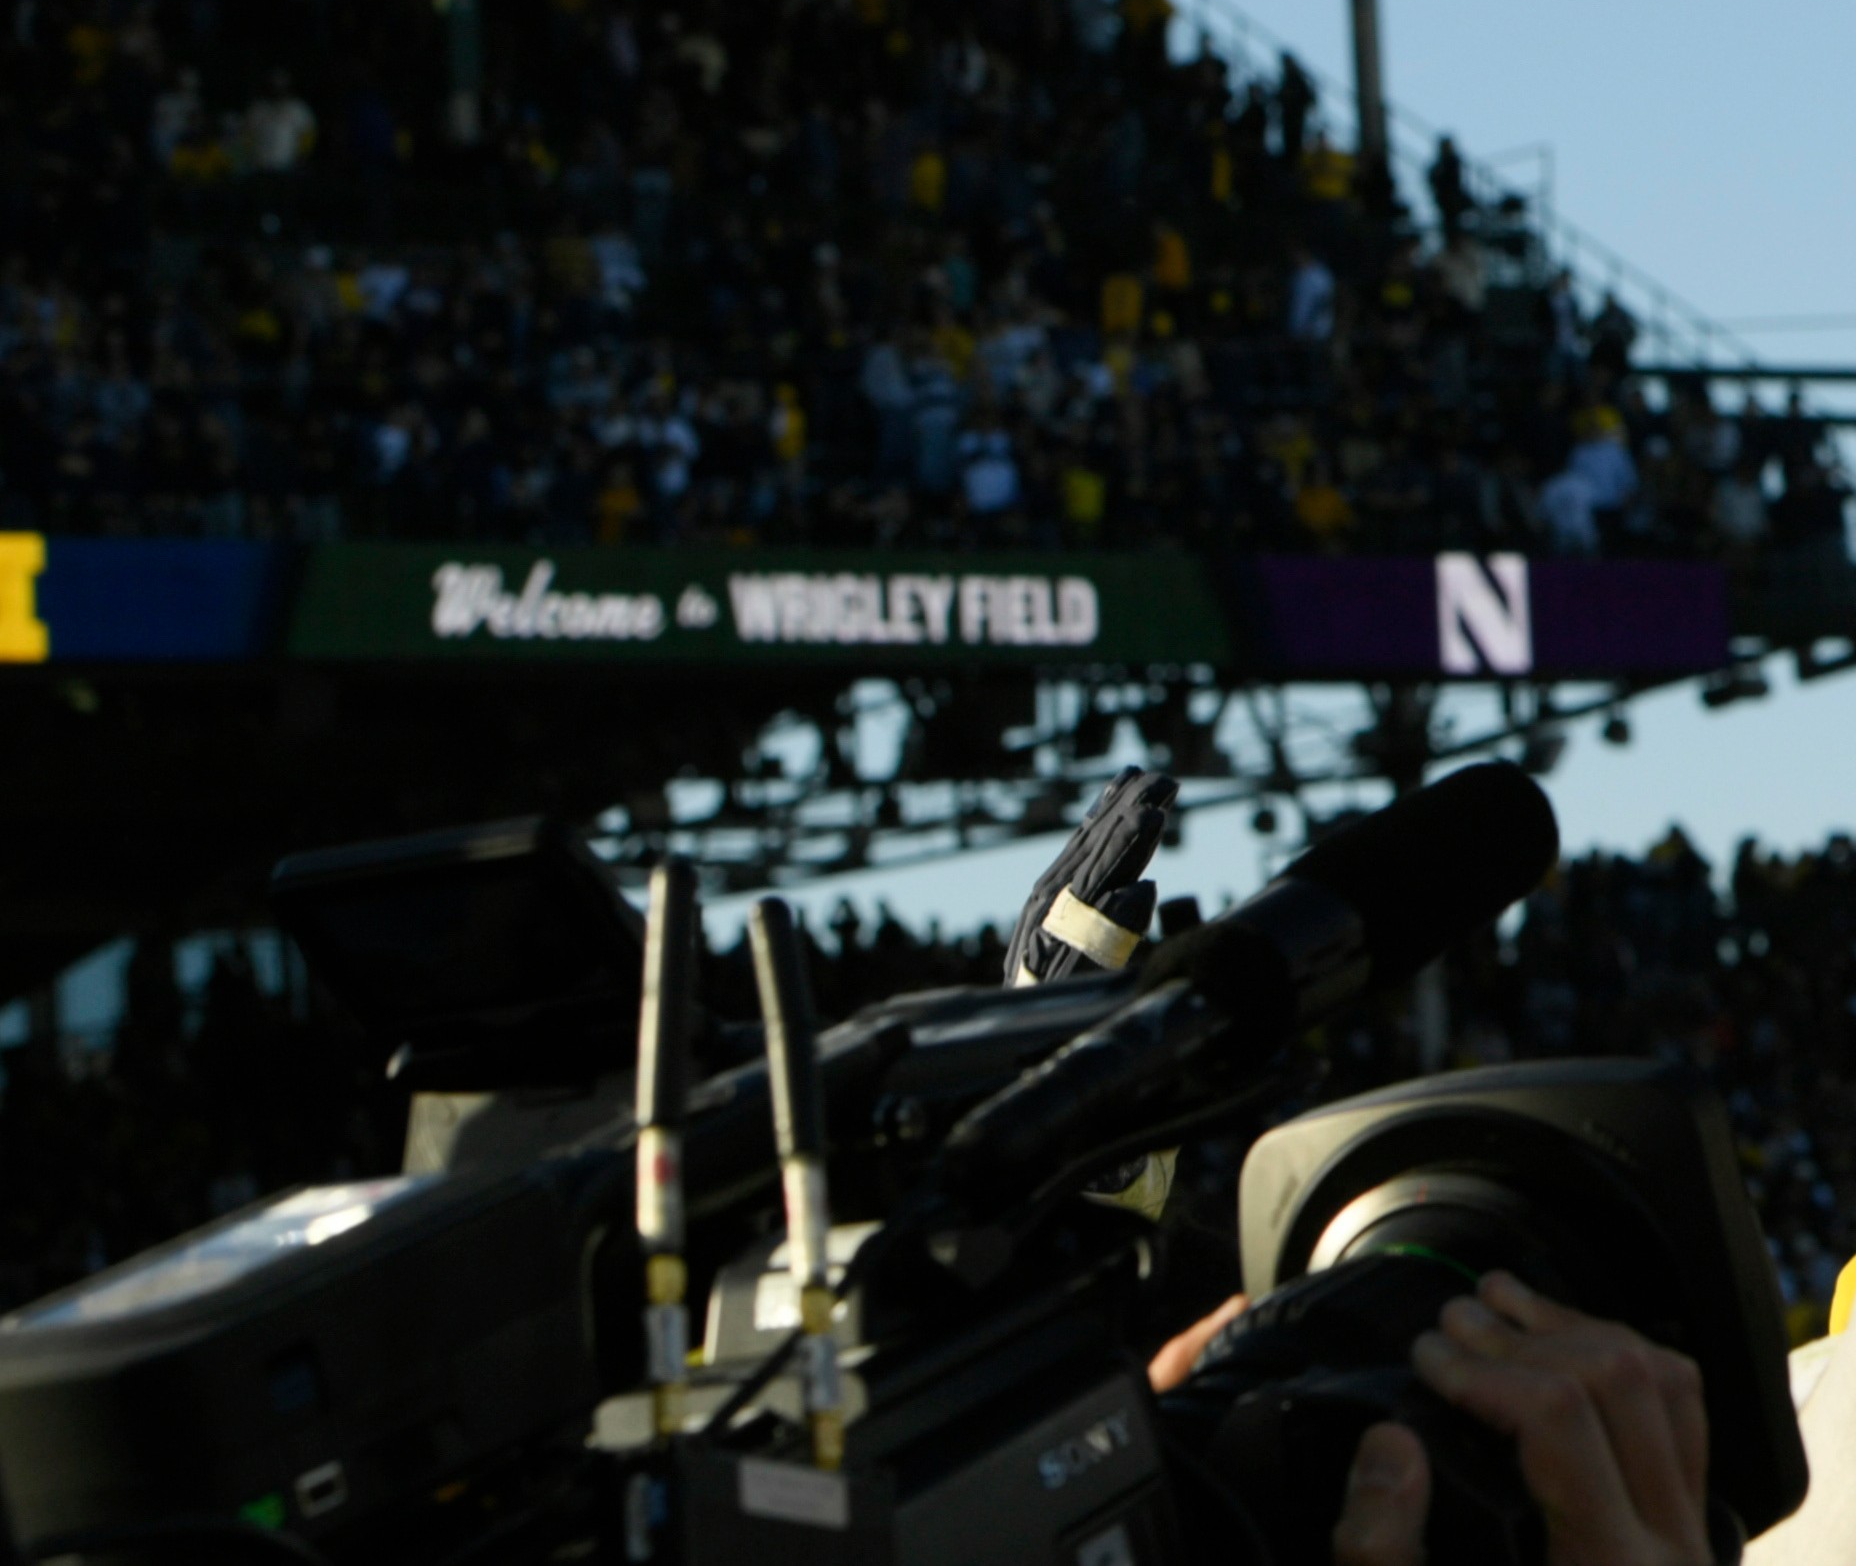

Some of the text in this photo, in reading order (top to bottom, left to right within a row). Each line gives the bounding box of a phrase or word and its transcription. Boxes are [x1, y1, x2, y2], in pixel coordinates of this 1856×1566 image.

[432, 556, 1101, 646] Welcome to WRIGLEY FIELD
[1435, 551, 1533, 673] N
